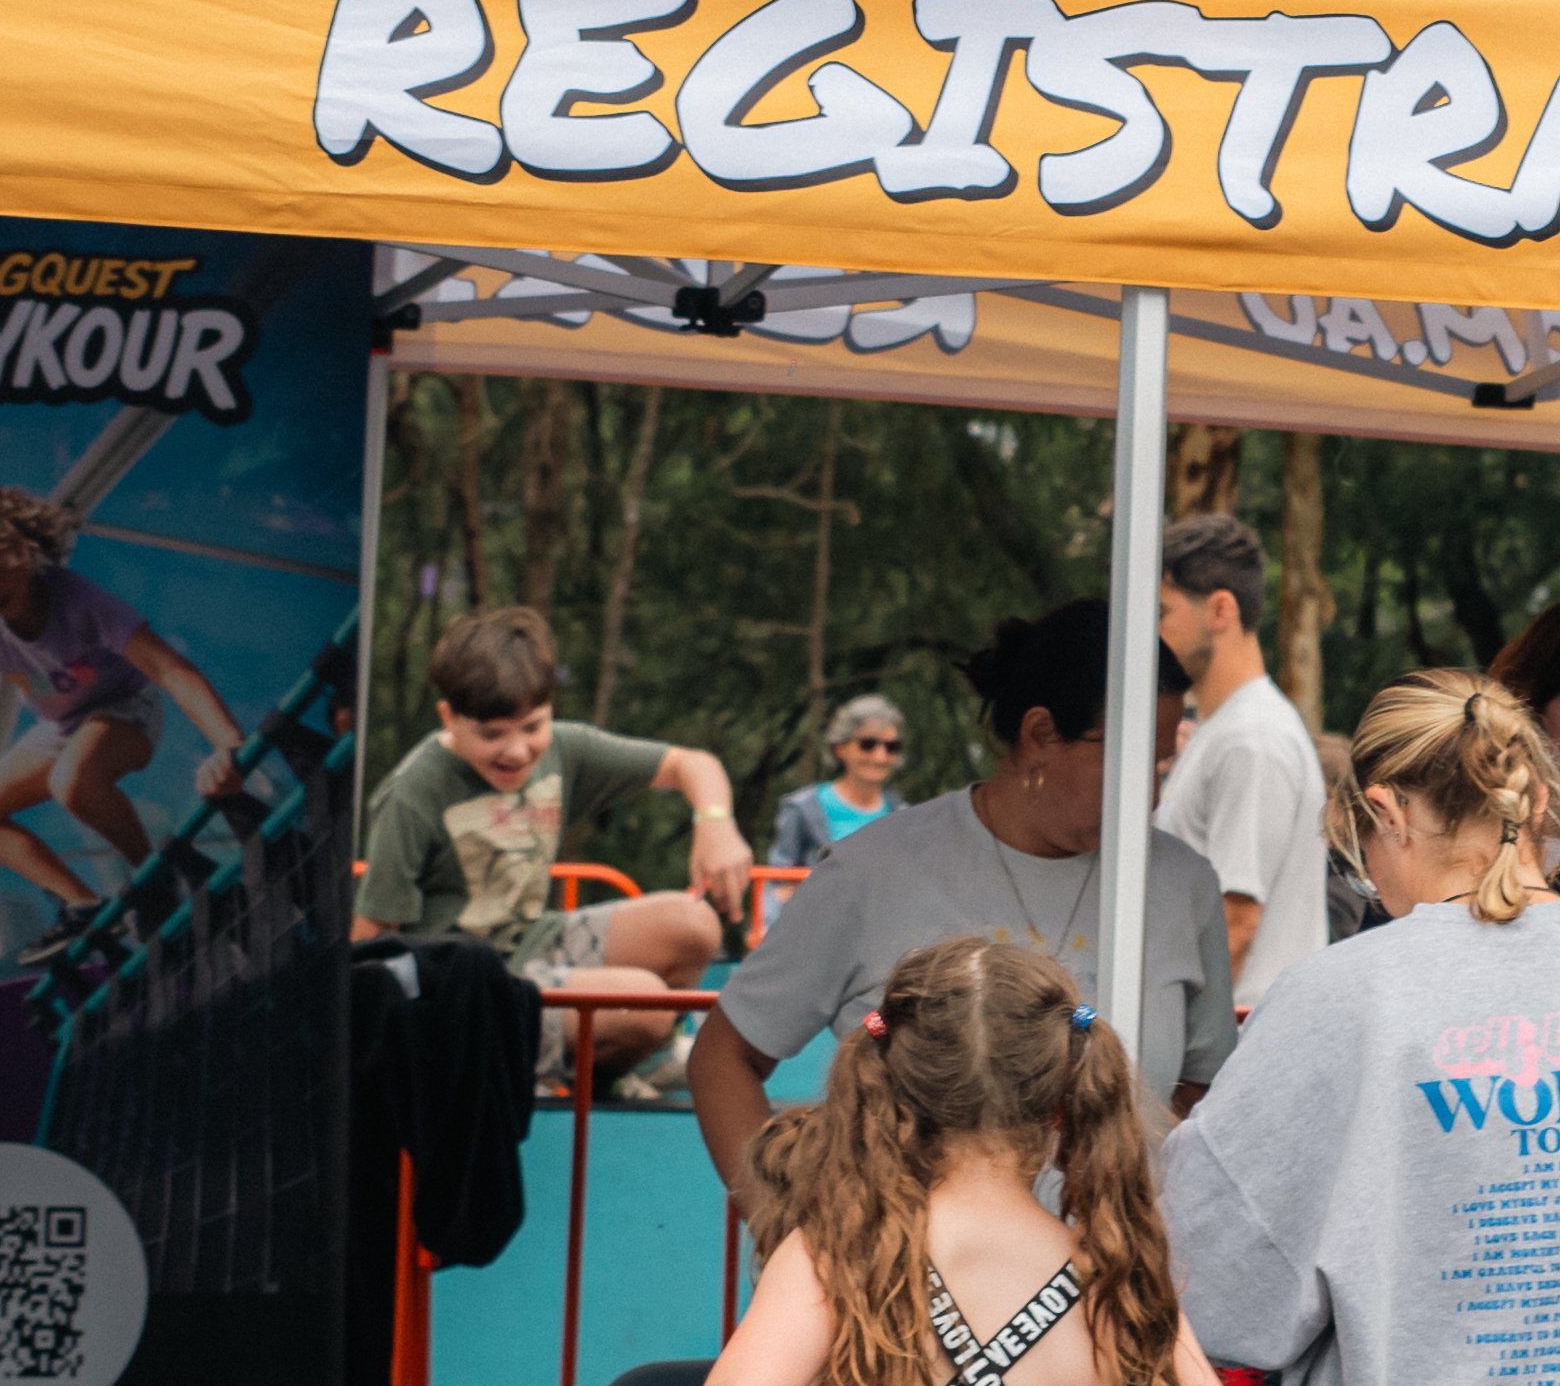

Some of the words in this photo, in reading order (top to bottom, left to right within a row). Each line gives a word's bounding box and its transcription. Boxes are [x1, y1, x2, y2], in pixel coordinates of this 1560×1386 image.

[1534, 1162, 1553, 1173] AM
[1483, 1250, 1503, 1261] AM
[1452, 1269, 1472, 1279] AM
[1533, 1313, 1549, 1323] AM
[1511, 1349, 1528, 1359] AM
[1499, 1367, 1518, 1376] AM
